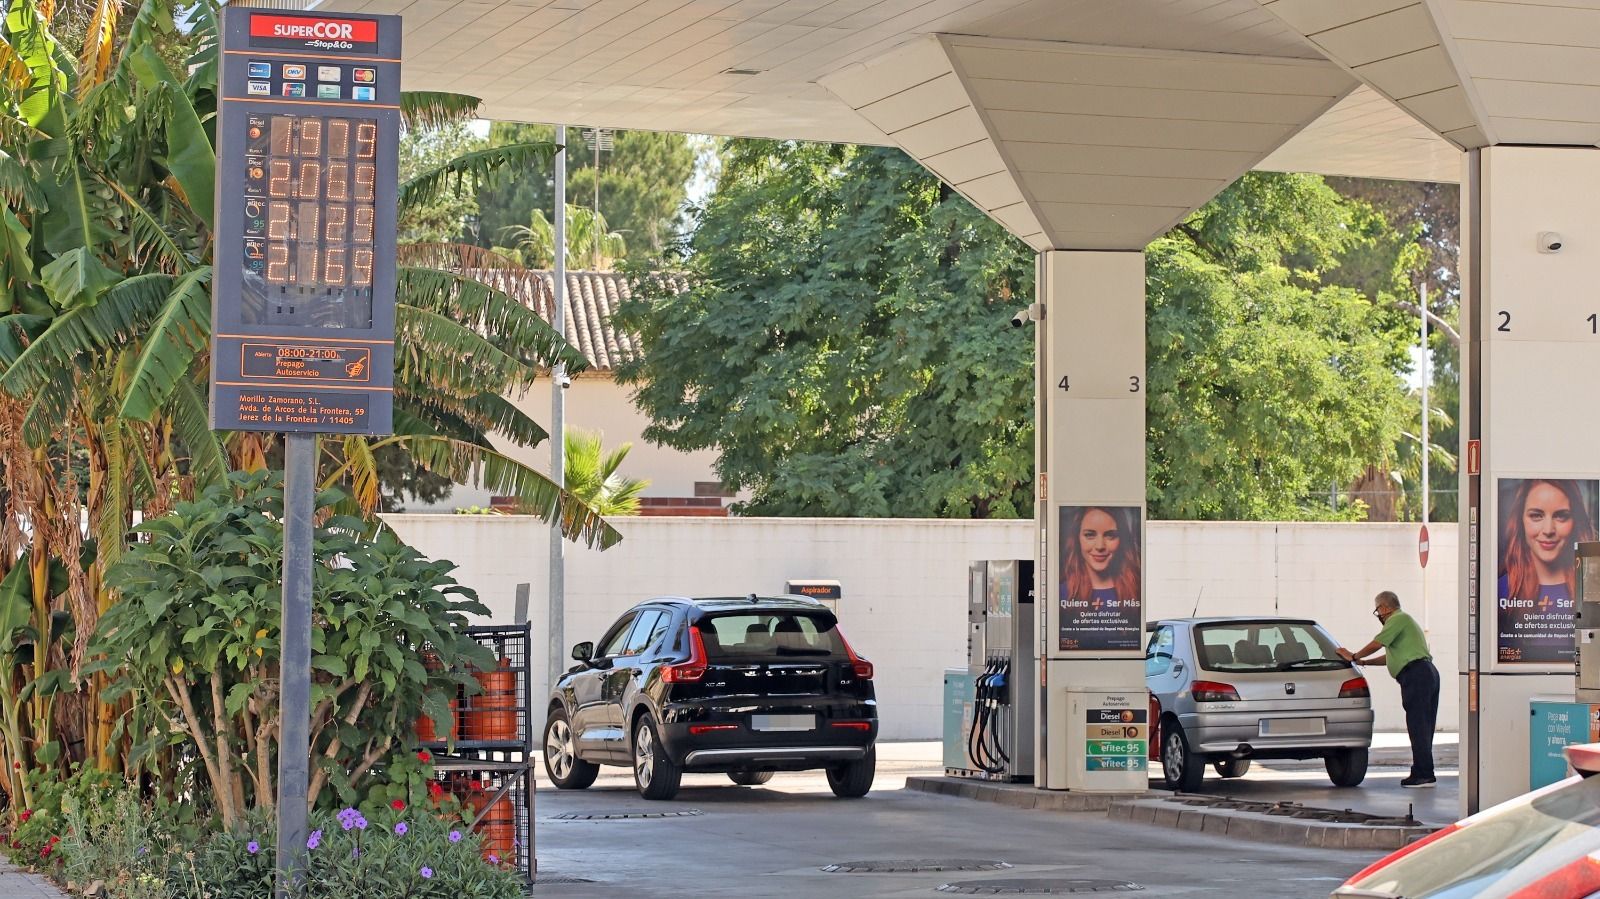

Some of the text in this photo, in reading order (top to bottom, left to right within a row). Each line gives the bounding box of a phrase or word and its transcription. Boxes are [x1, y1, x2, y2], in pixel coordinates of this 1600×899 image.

[274, 22, 352, 39] SUPERCOR
[313, 40, 352, 50] Stop&Go
[269, 162, 375, 199] 2.069
[253, 219, 265, 228] 95
[268, 204, 374, 241] 2.129
[252, 260, 264, 269] 95
[268, 246, 373, 283] 2.169
[1497, 310, 1511, 332] 2
[1586, 313, 1597, 334] 1
[276, 360, 305, 369] Prepago
[276, 369, 320, 377] Autoservicio
[1058, 375, 1070, 392] 4
[1129, 375, 1140, 393] 3
[239, 395, 321, 405] Morillo Zamorano, S.L.
[320, 407, 352, 416] Frontera,
[355, 408, 365, 416] 59
[239, 413, 259, 421] Jerez
[275, 414, 282, 422] la
[286, 415, 318, 423] Frontera
[329, 416, 354, 424] 11405
[800, 586, 832, 595] Aspirador
[1060, 599, 1089, 609] Quiero
[1106, 599, 1121, 607] Ser
[1123, 598, 1141, 607] Más
[1499, 597, 1534, 610] Quiero
[1556, 598, 1575, 608] Ser
[1523, 613, 1545, 621] Quiero
[1100, 712, 1120, 720] Diesel
[1101, 728, 1121, 736] Diesel
[1547, 736, 1552, 746] y
[1101, 744, 1139, 752] efitec 95
[1101, 759, 1139, 768] efitec 95
